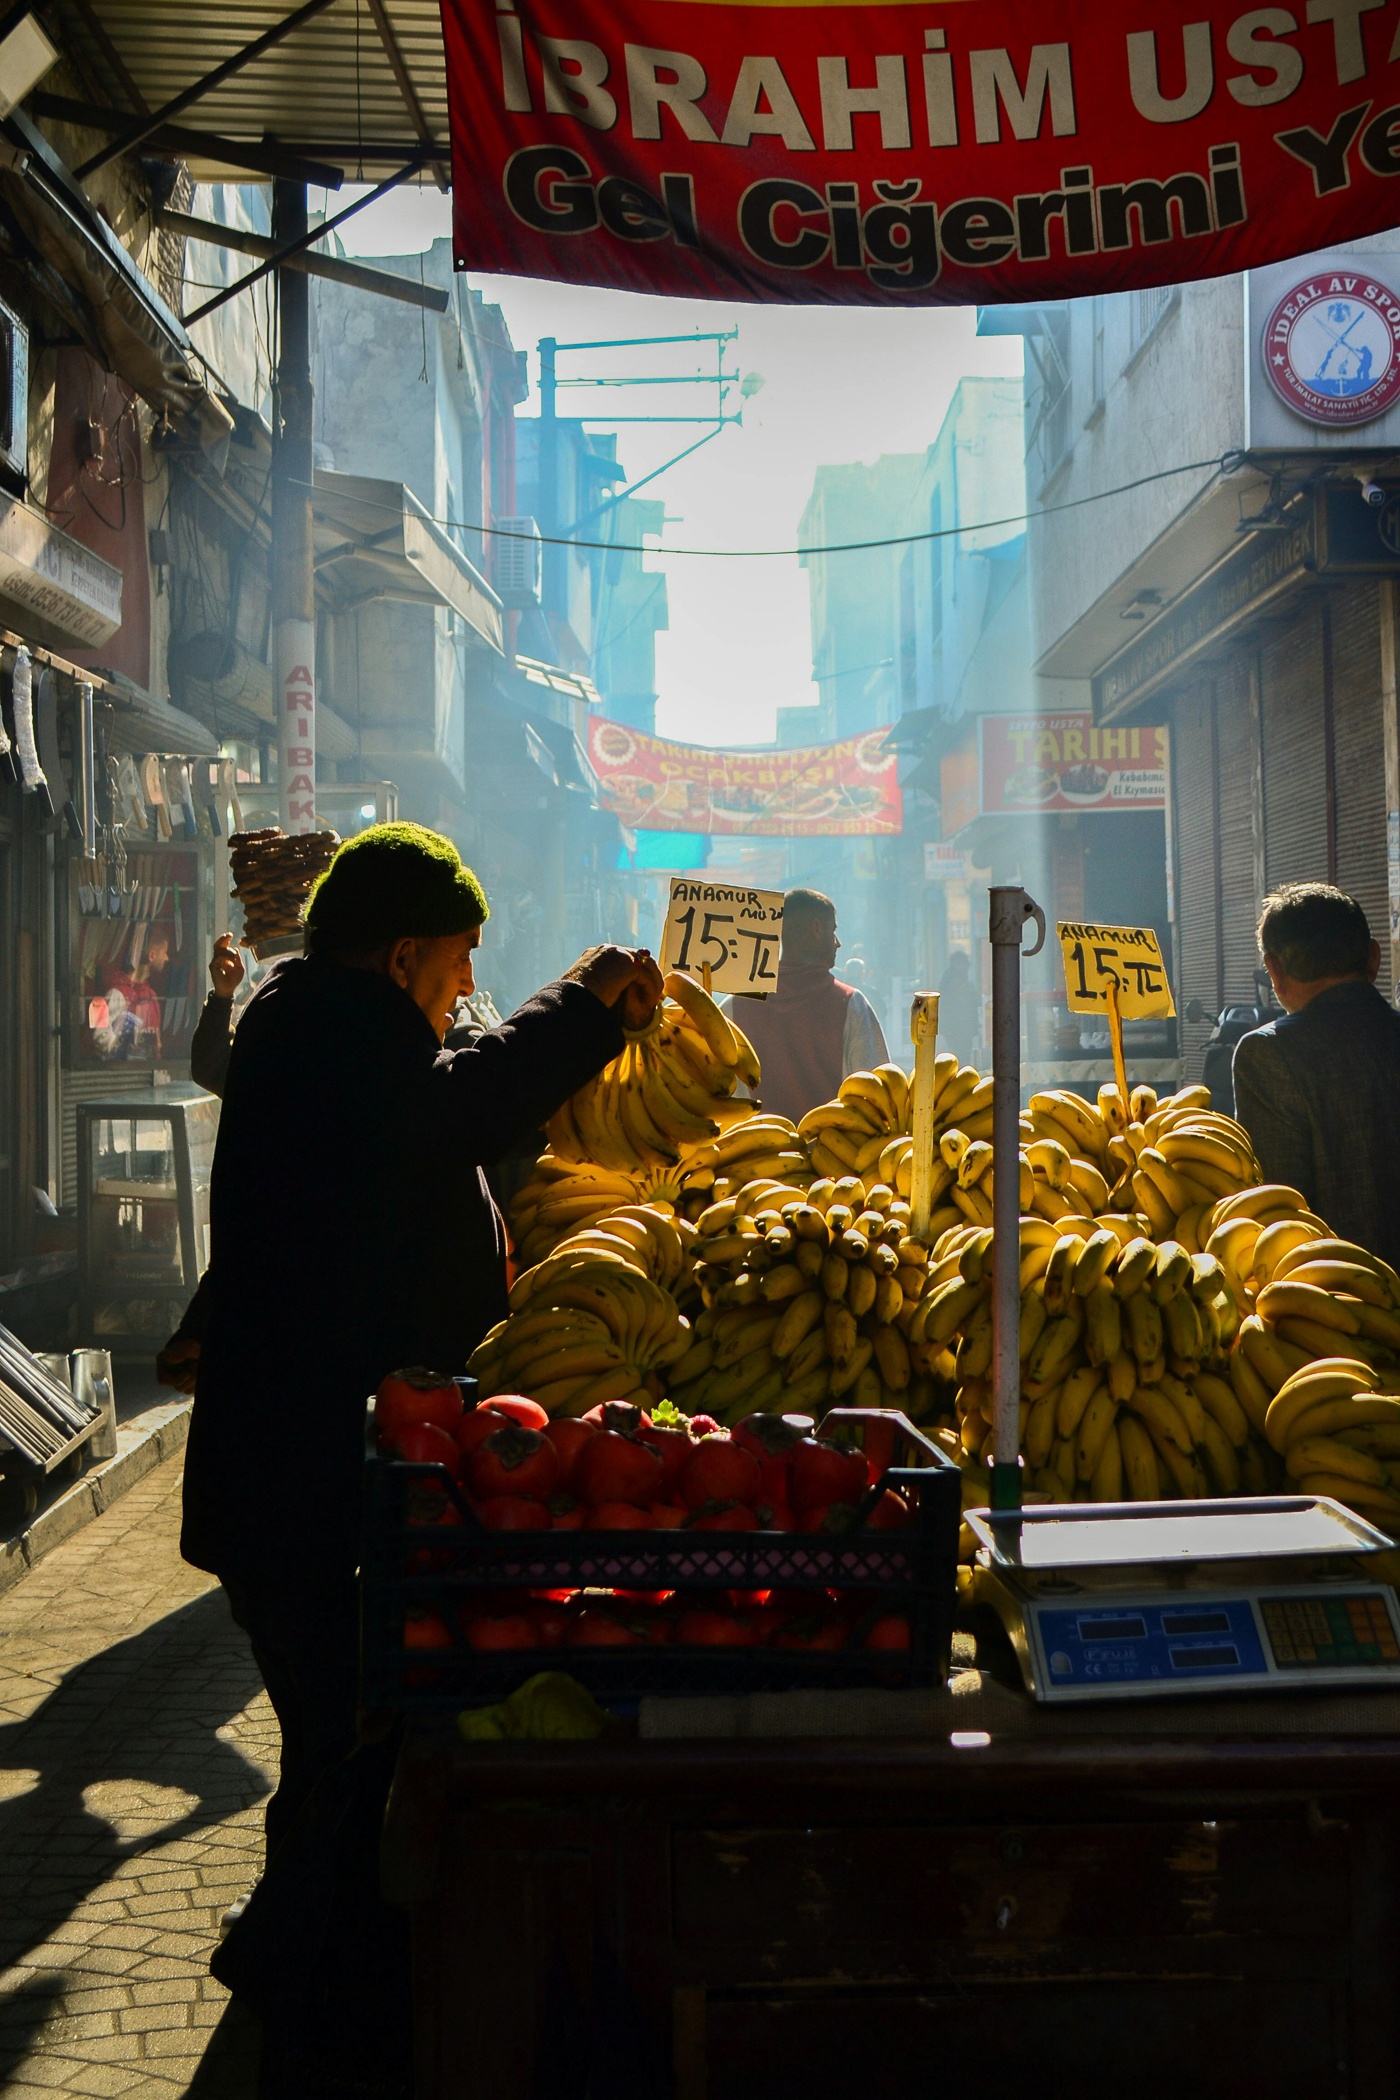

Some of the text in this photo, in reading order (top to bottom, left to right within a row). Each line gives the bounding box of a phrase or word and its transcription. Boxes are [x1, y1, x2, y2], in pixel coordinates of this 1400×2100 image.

[497, 0, 1400, 151] İBRAHİM UST
[503, 144, 702, 249] Gel
[737, 142, 1248, 291] Ciğerimi
[1271, 284, 1322, 344] İDEAL
[1328, 277, 1358, 292] AV
[1050, 718, 1084, 729] USTA
[659, 760, 834, 788] OCAKBAŞI
[672, 883, 762, 909] ANAMUR
[1061, 924, 1157, 953] ANAMUR
[1102, 1649, 1134, 1661] FUJI
